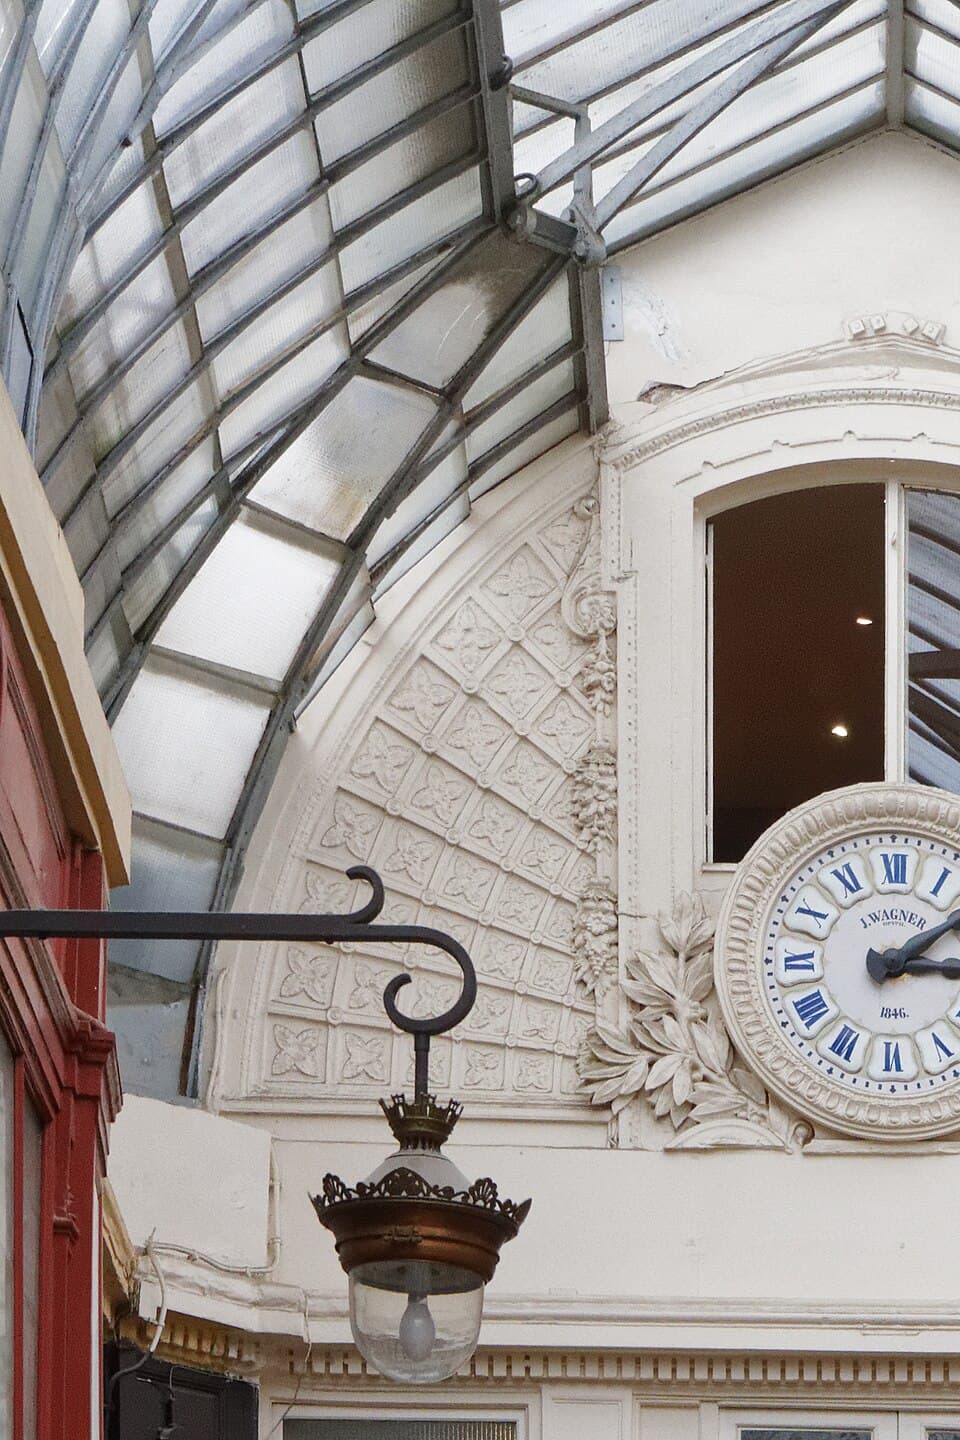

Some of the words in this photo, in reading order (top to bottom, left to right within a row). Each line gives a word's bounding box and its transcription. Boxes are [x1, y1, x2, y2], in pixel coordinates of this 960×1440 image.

[830, 863, 864, 898] XI
[880, 853, 908, 884] XII
[795, 899, 829, 929] X
